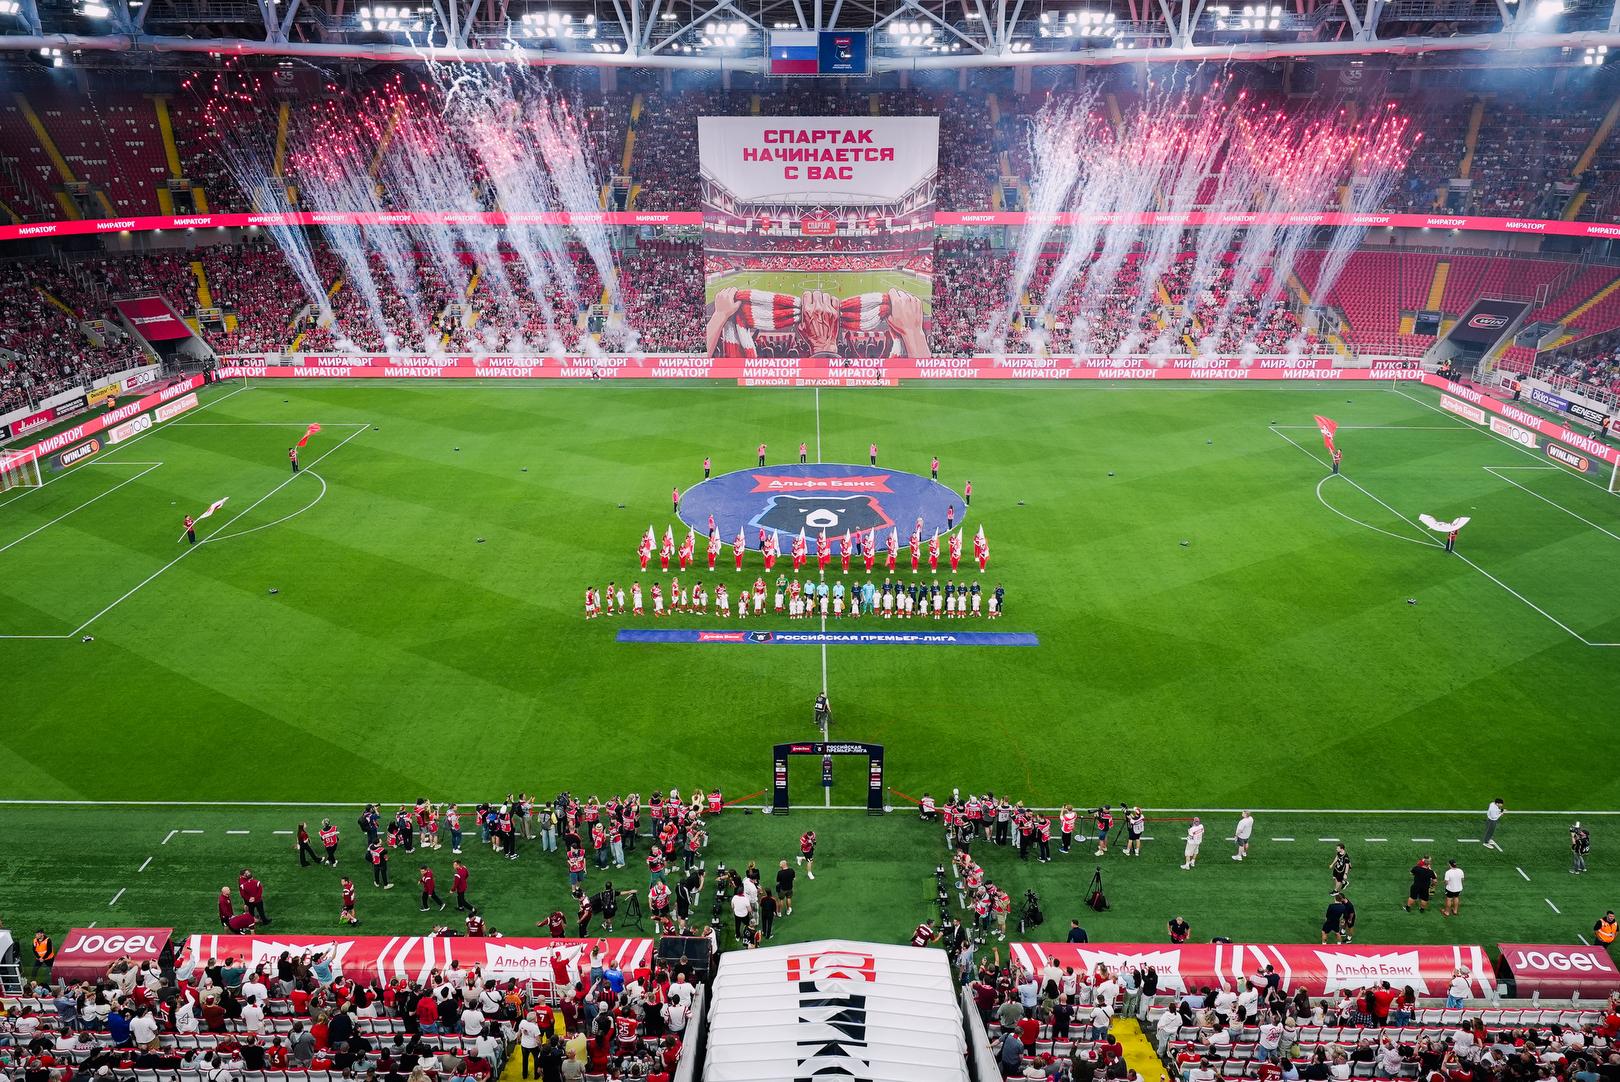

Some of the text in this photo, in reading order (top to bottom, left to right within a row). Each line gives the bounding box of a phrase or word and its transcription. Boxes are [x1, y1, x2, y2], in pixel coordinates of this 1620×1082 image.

[764, 130, 873, 144] СПАРТАК
[743, 148, 894, 162] НАЧИНАЕТСЯ
[784, 166, 853, 180] С ВАС
[174, 217, 211, 226] МИРАТОРГ
[248, 214, 284, 223] МИРАТОРГ
[312, 214, 346, 222] МИРАТОРГ
[1289, 215, 1324, 223] МИРАТОРГ
[1353, 216, 1389, 224] МИРАТОРГ
[1427, 218, 1467, 226] МИРАТОРГ
[19, 225, 57, 235] МИРАТОРГ
[97, 220, 136, 230] МИРАТОРГ
[1506, 221, 1546, 230] МИРАТОРГ
[1587, 226, 1620, 235] МИРАТО
[403, 357, 458, 367] МИРАТОРГ
[489, 358, 544, 367] МИРАТОРГ
[659, 358, 715, 368] МИРАТОРГ
[744, 358, 801, 368] МИРАТОРГ
[828, 358, 885, 368] МИРАТОРГ
[915, 358, 972, 368] МИРАТОРГ
[1001, 359, 1058, 368] МИРАТОРГ
[1086, 359, 1143, 368] МИРАОРГ
[1260, 359, 1317, 369] МИРАТОРГ
[294, 367, 352, 377] МИРАТОРГ
[384, 367, 443, 377] МИРАТОРГ
[475, 367, 534, 377] МИРАТОРГ
[560, 367, 618, 377] МИРАОРГ
[651, 367, 710, 377] МИРАТОРГ
[742, 367, 801, 378] МИРАТОРГ
[920, 368, 980, 378] МИРАТОРГ
[1012, 368, 1072, 378] МИРАТОРГ
[1098, 369, 1158, 378] МИРАТОРГ
[1190, 369, 1250, 379] МИРАТОРГ
[1282, 369, 1343, 379] МИРАТОРГ
[1369, 369, 1424, 382] МИРАТОРГ
[754, 378, 790, 386] ЛУКОЙЛ
[805, 378, 840, 386] ЛУКОЙЛ
[160, 380, 193, 401] МИРАТОРГ
[1447, 381, 1482, 405] МИРАТОРГ
[102, 401, 141, 428] МИРАТОРГ
[1500, 404, 1543, 430] МИРАТОРГ
[1571, 404, 1604, 424] GENESIS
[38, 426, 84, 455] МИРАТОРГ
[1560, 430, 1610, 460] МИРАТОРГ
[62, 443, 92, 463] WINLINE
[1549, 446, 1580, 466] WINLINE
[768, 479, 876, 488] Альфа Банк
[776, 633, 957, 642] РОССИЙСКАЯ ПРЕМЬЕР-ЛИГА
[494, 955, 537, 970] Альфа
[1336, 963, 1413, 979] Альфа Банк
[539, 1014, 546, 1022] 7
[618, 1023, 630, 1035] 25
